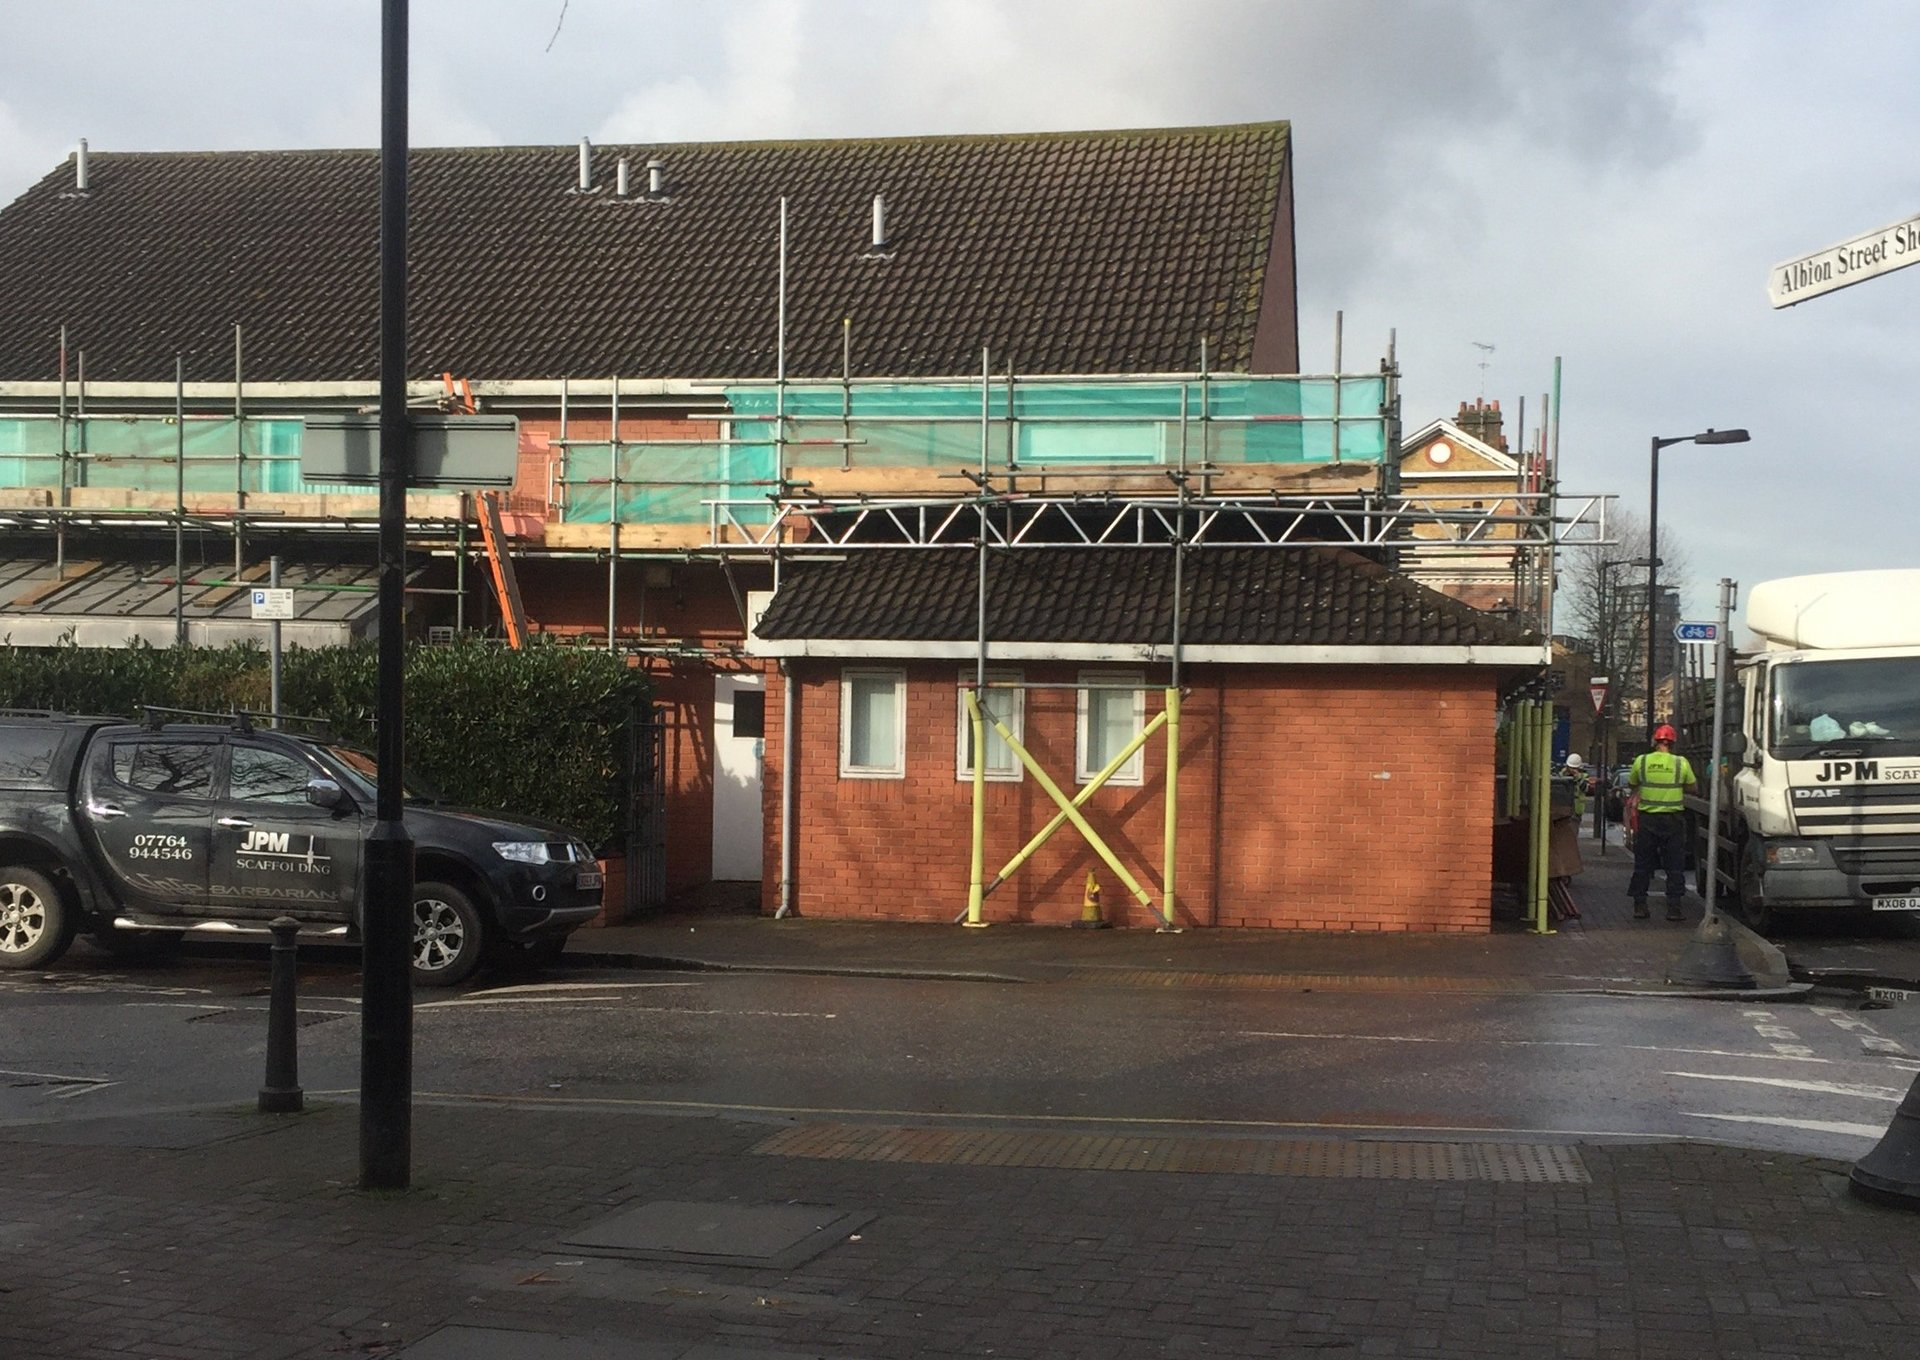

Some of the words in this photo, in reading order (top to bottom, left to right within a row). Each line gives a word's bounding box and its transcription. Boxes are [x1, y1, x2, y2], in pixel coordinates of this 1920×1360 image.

[1781, 261, 1832, 294] Albion
[1838, 236, 1888, 273] Street
[1895, 224, 1920, 255] Sh
[1816, 761, 1878, 782] JPM
[1885, 769, 1920, 781] SCAF
[1796, 789, 1841, 799] DAF
[135, 834, 187, 848] 07764
[241, 831, 290, 852] JPM
[129, 847, 192, 860] 944546
[209, 885, 338, 899] BARBARIAN
[1878, 899, 1906, 909] MX08
